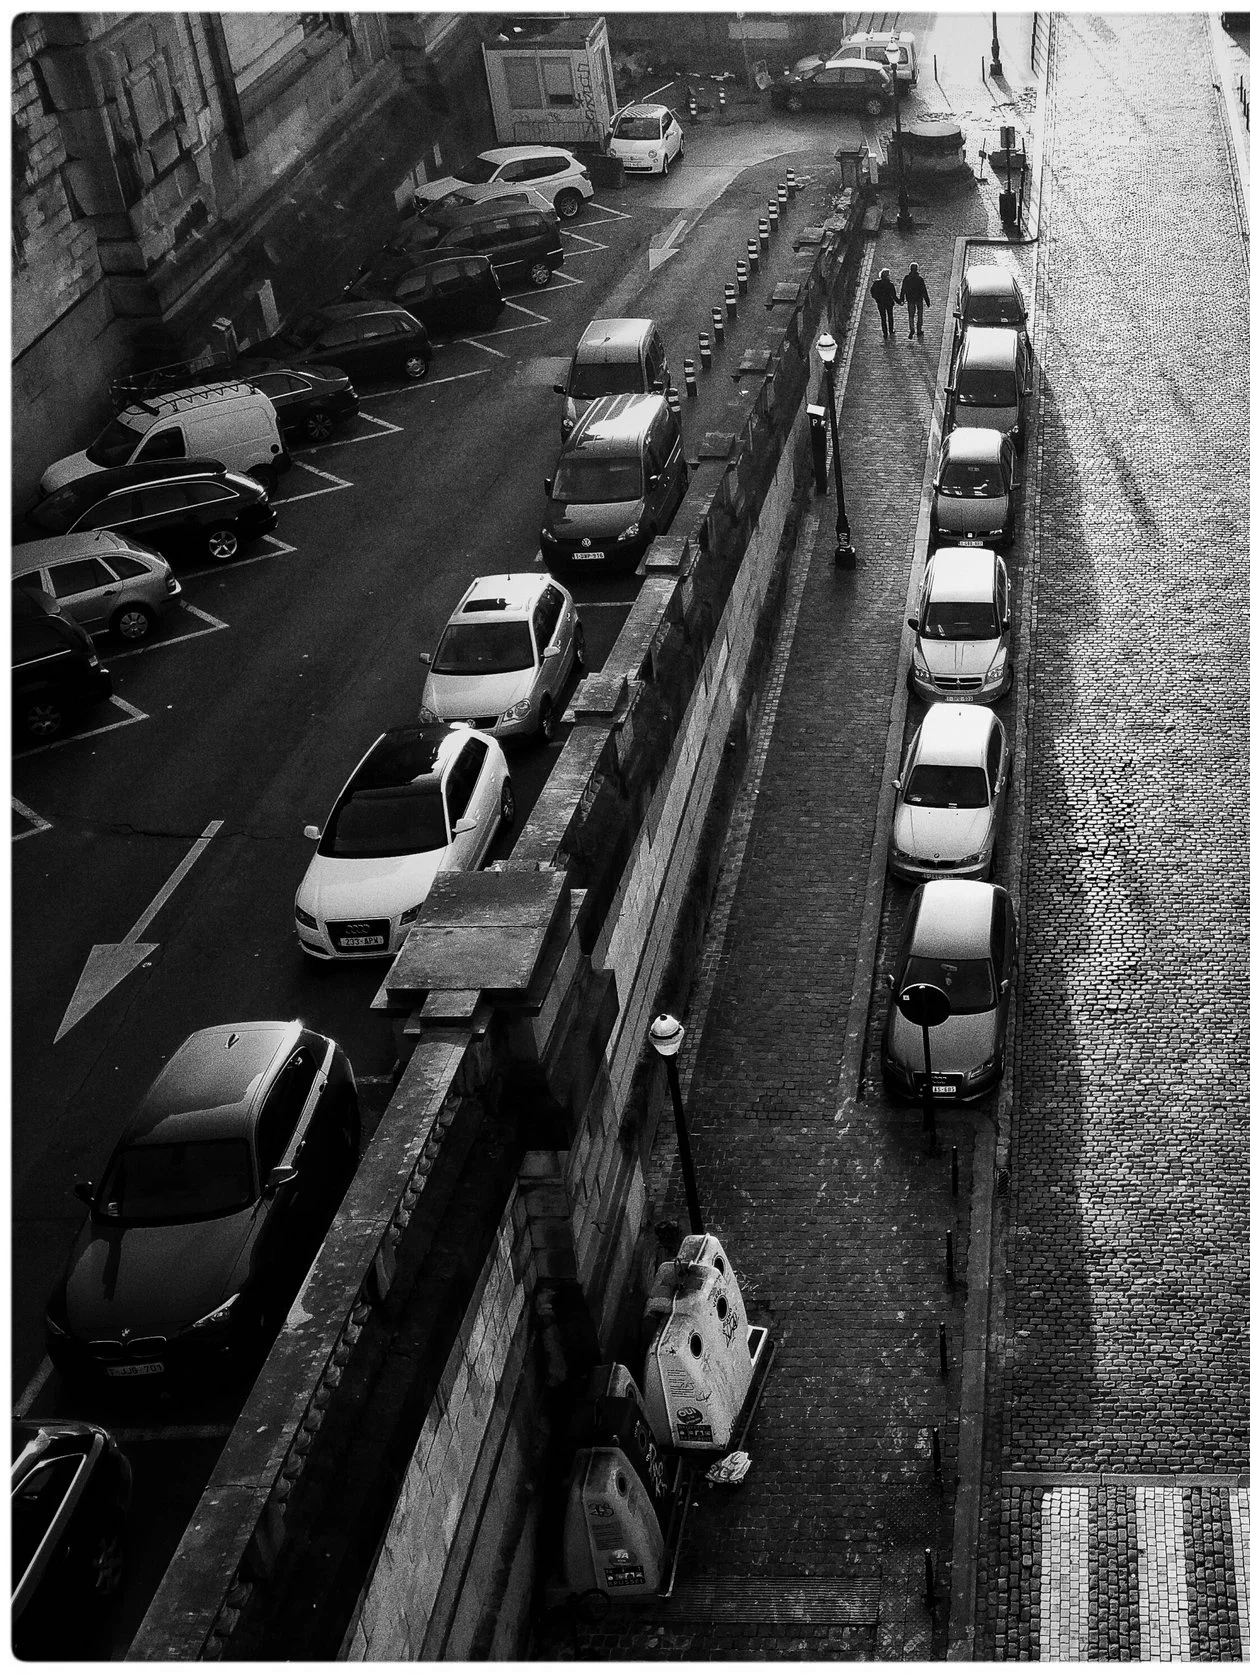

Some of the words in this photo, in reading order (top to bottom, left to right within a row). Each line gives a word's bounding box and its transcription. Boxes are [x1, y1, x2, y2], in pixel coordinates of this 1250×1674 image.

[812, 418, 818, 427] P
[677, 1408, 697, 1417] OUI
[615, 1552, 630, 1560] JA
